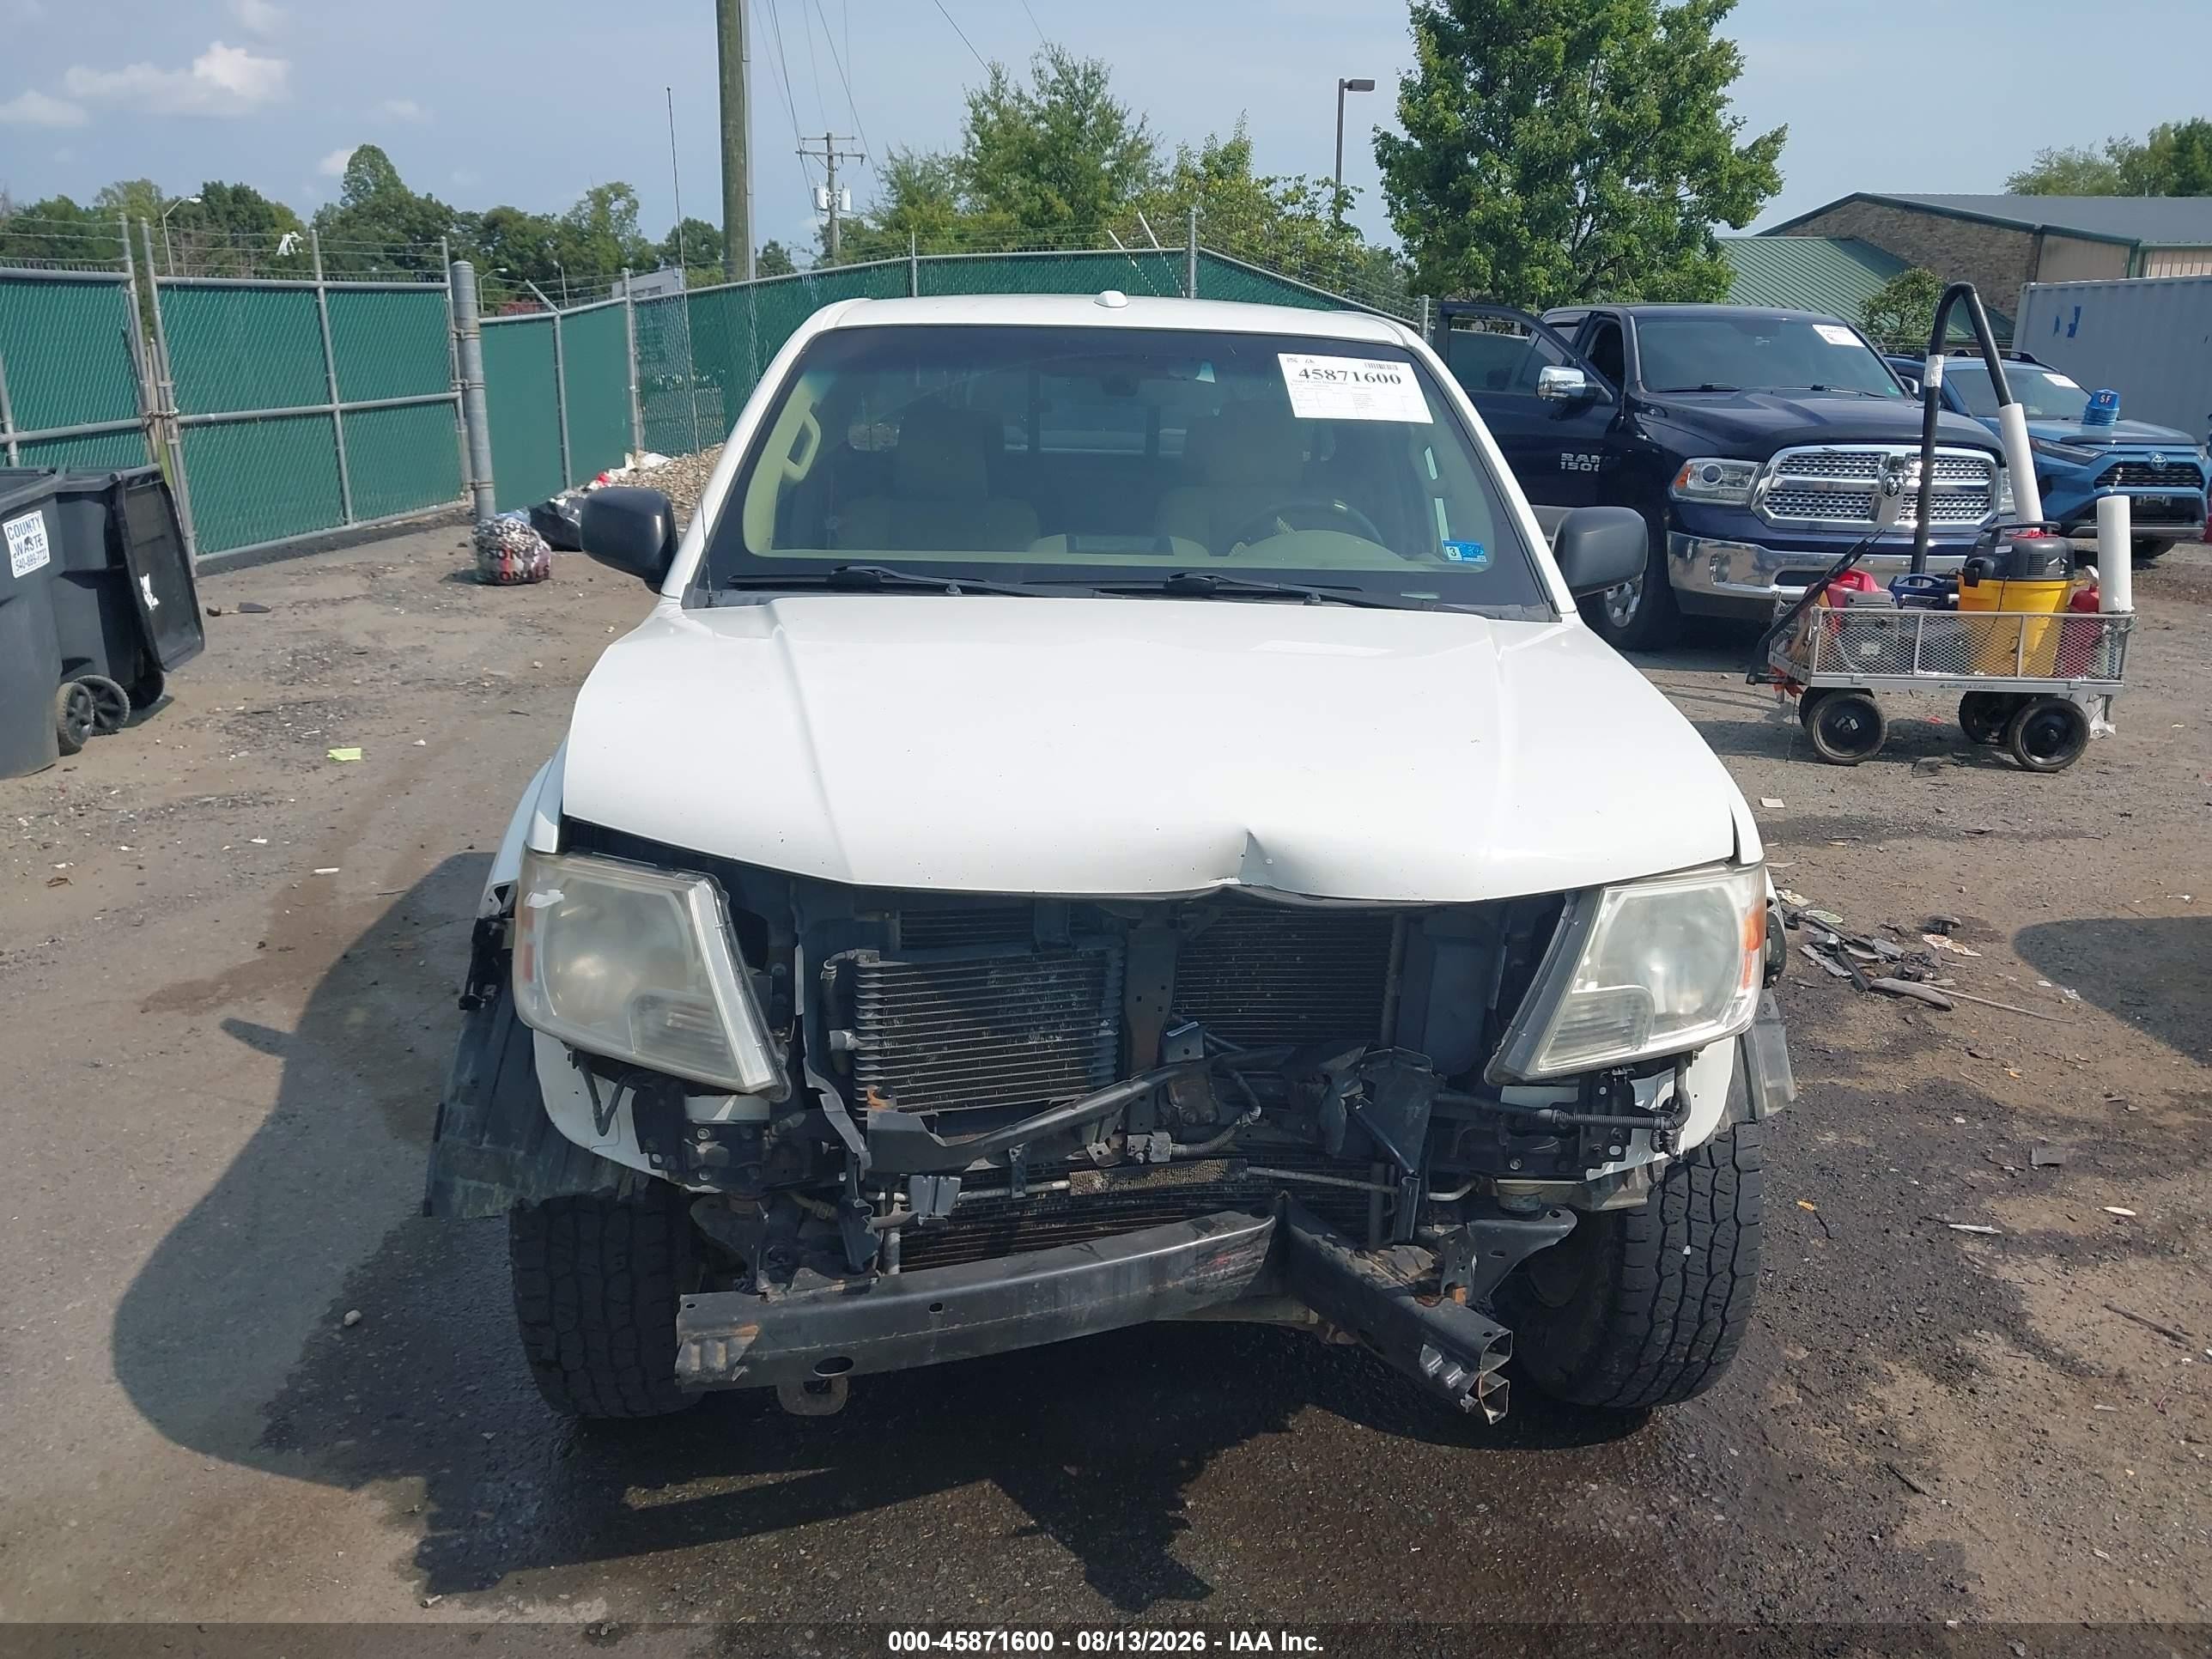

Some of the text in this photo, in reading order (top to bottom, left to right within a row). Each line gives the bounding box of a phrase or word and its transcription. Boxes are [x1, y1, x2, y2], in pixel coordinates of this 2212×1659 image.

[1299, 368, 1401, 386] 45871600
[7, 516, 41, 540] COUNTY
[13, 533, 44, 556] WASTE
[1449, 548, 1457, 557] 3
